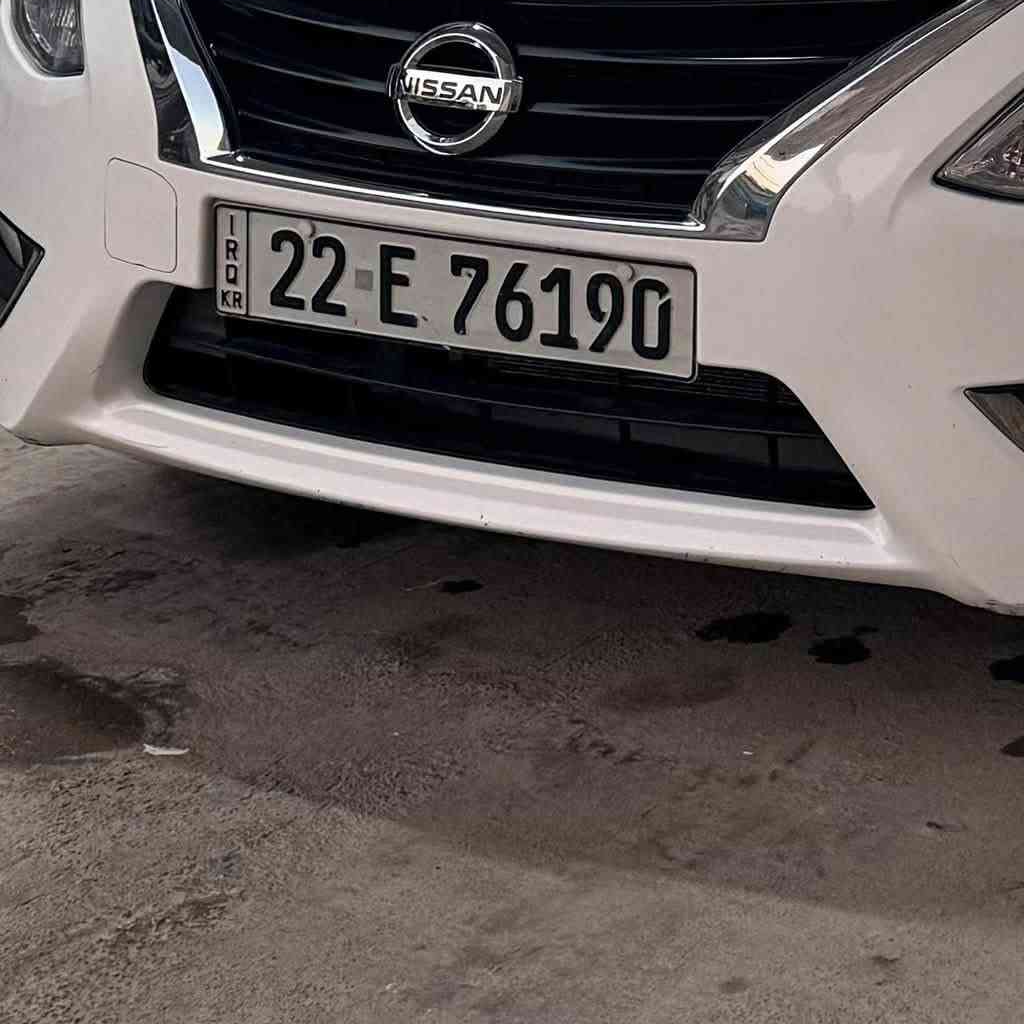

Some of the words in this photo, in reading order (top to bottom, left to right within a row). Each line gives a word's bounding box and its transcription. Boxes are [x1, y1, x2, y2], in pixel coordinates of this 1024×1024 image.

[401, 76, 502, 105] NISSAN
[221, 289, 242, 309] KR
[270, 229, 347, 317] 22
[380, 244, 418, 328] E
[450, 254, 672, 360] 76190
